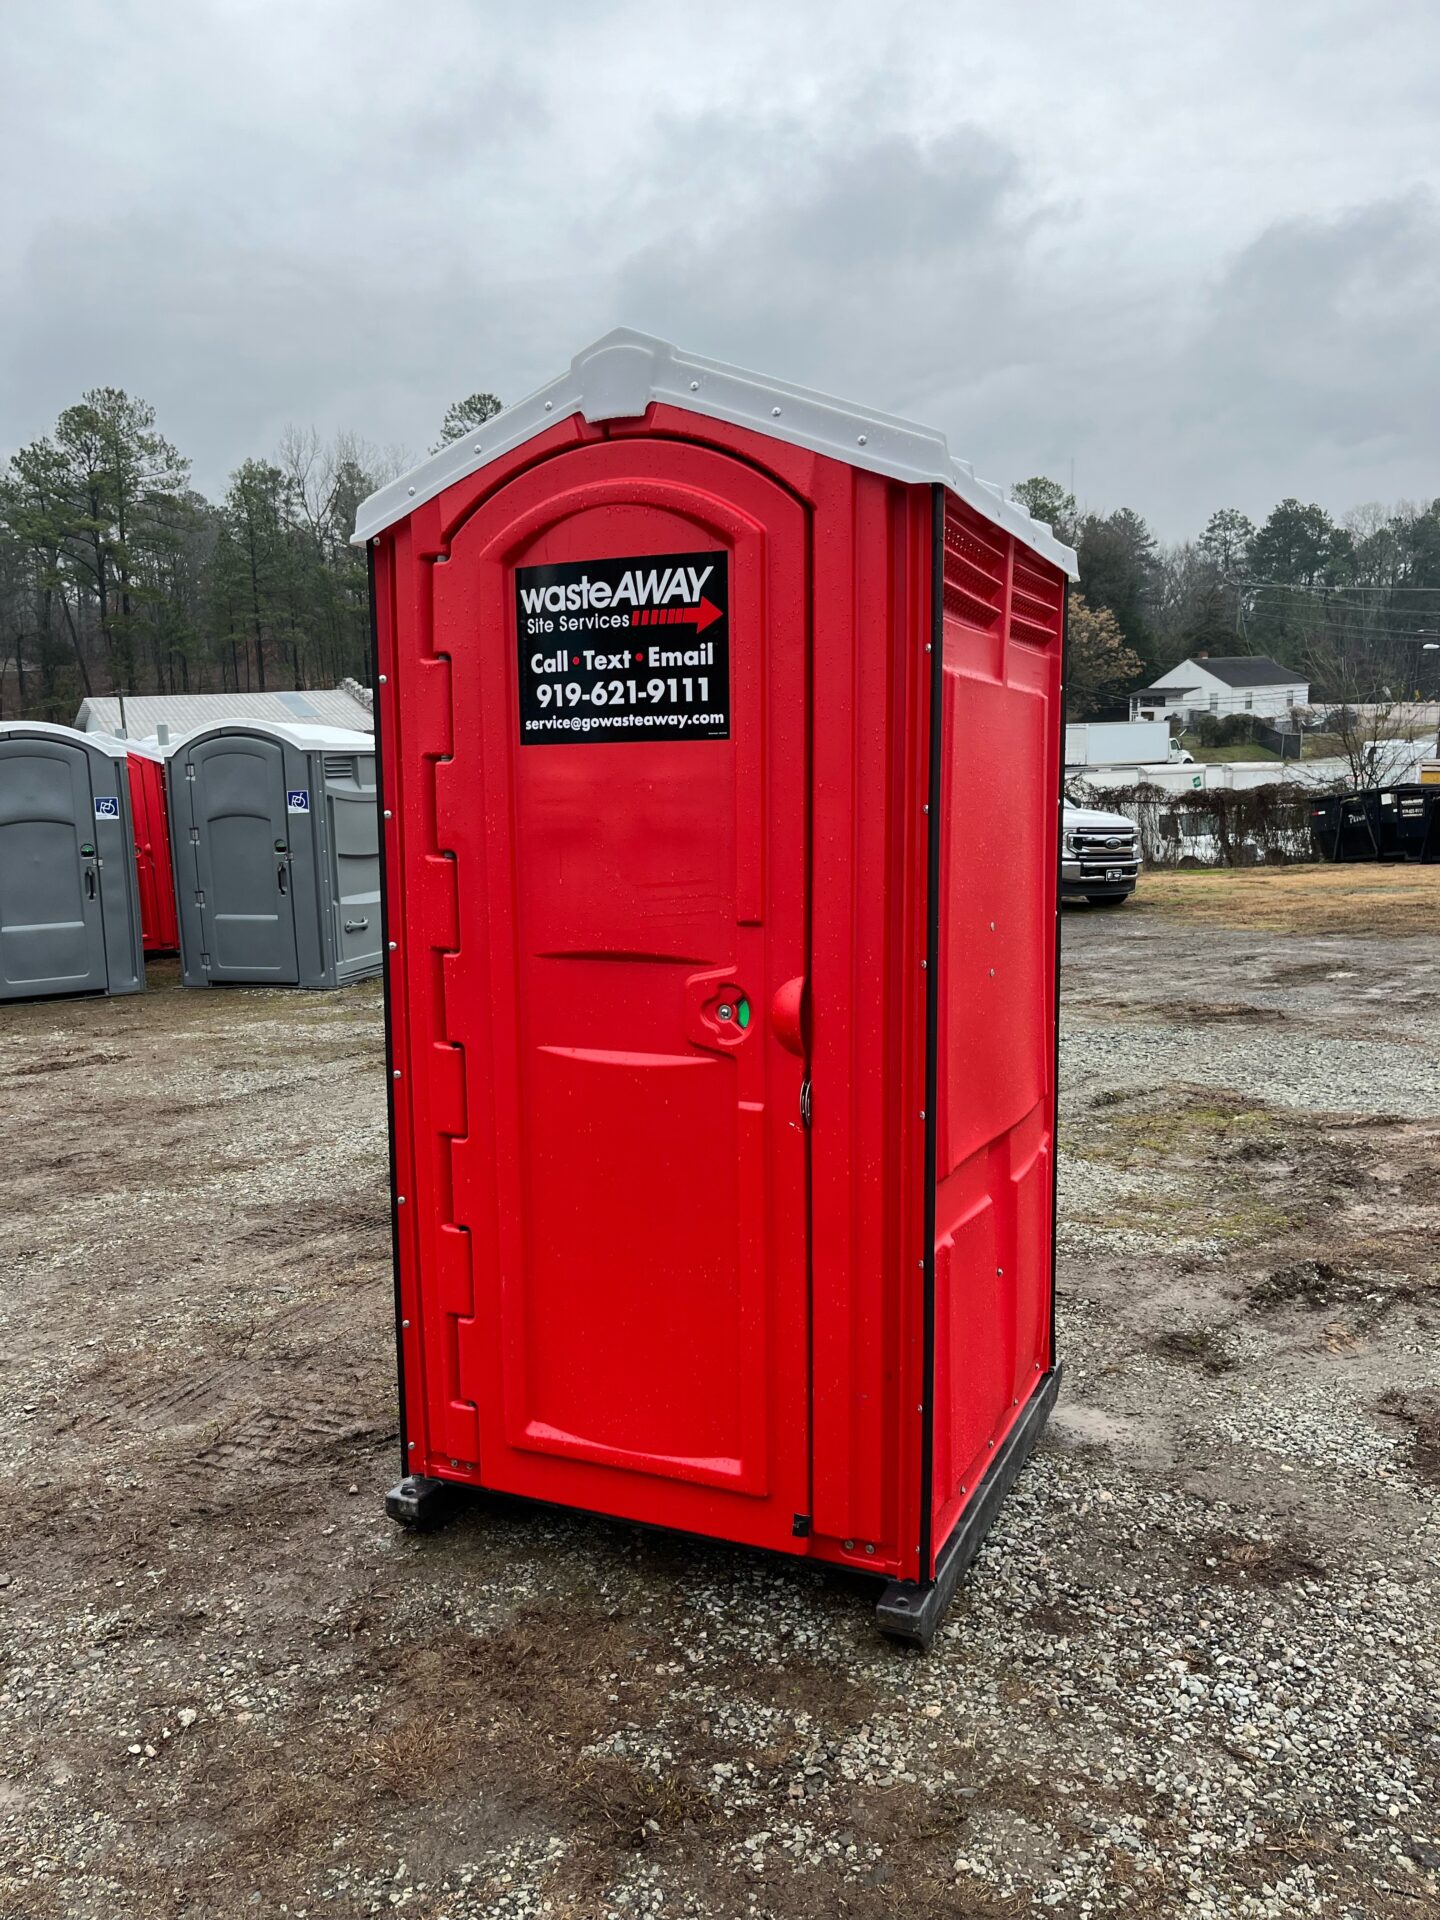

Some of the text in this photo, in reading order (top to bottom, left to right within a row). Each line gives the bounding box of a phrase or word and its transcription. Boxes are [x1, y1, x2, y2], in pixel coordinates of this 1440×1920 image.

[520, 566, 715, 614] wasteAWAY
[527, 613, 630, 634] Site Services
[530, 642, 714, 674] Call Text Email
[536, 677, 709, 708] 919-621-9111
[525, 713, 725, 731] service@gowasteaway.com
